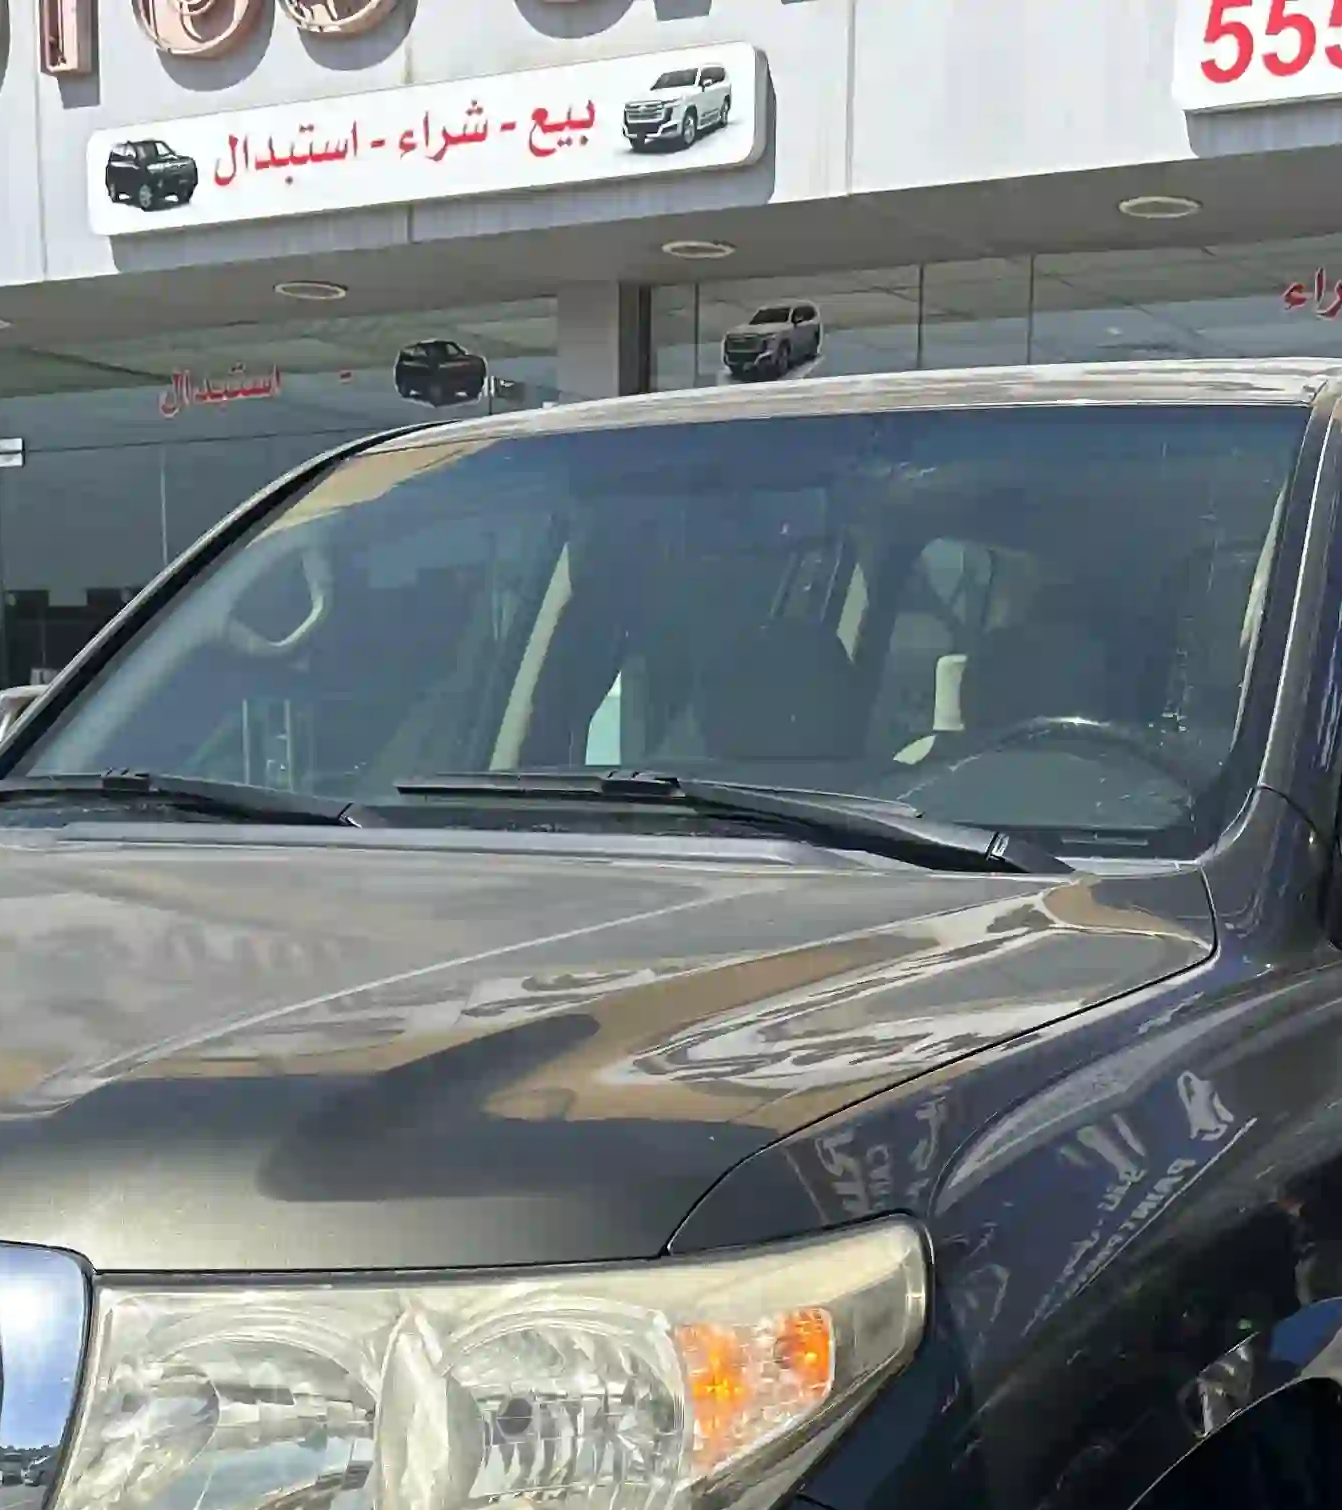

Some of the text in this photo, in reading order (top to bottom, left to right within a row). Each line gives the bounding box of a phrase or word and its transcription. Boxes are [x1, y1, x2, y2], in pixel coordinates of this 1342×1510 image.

[213, 99, 596, 187] بيع - شراء - استبدال
[159, 362, 281, 418] استبدال
